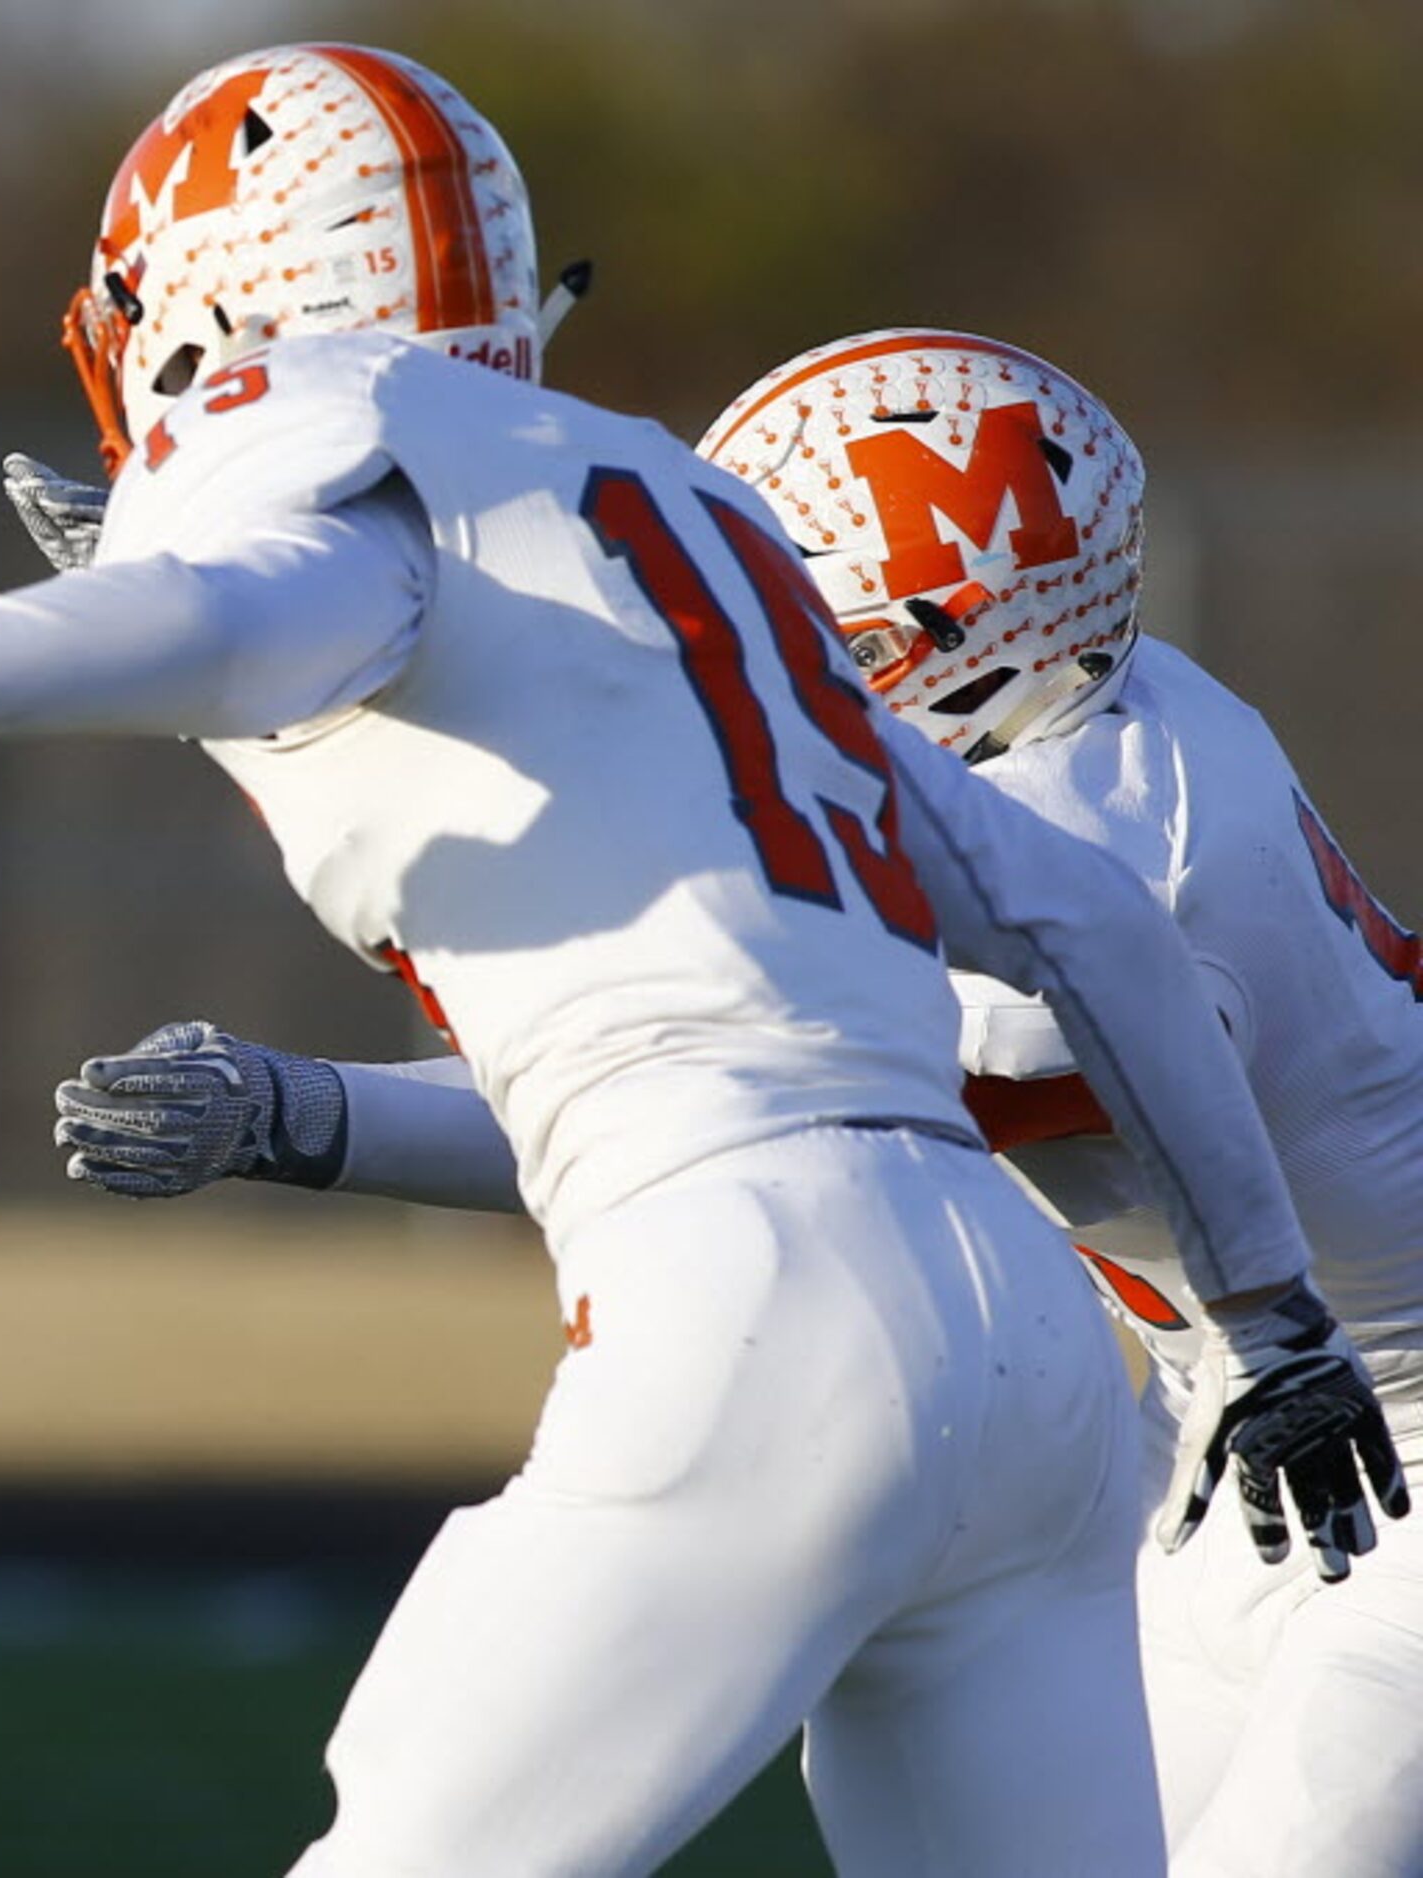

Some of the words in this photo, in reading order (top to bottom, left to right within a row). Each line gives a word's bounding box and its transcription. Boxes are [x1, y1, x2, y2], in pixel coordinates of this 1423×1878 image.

[99, 68, 274, 260] M
[364, 247, 397, 275] 15
[844, 401, 1081, 600] M
[580, 464, 939, 957] 15
